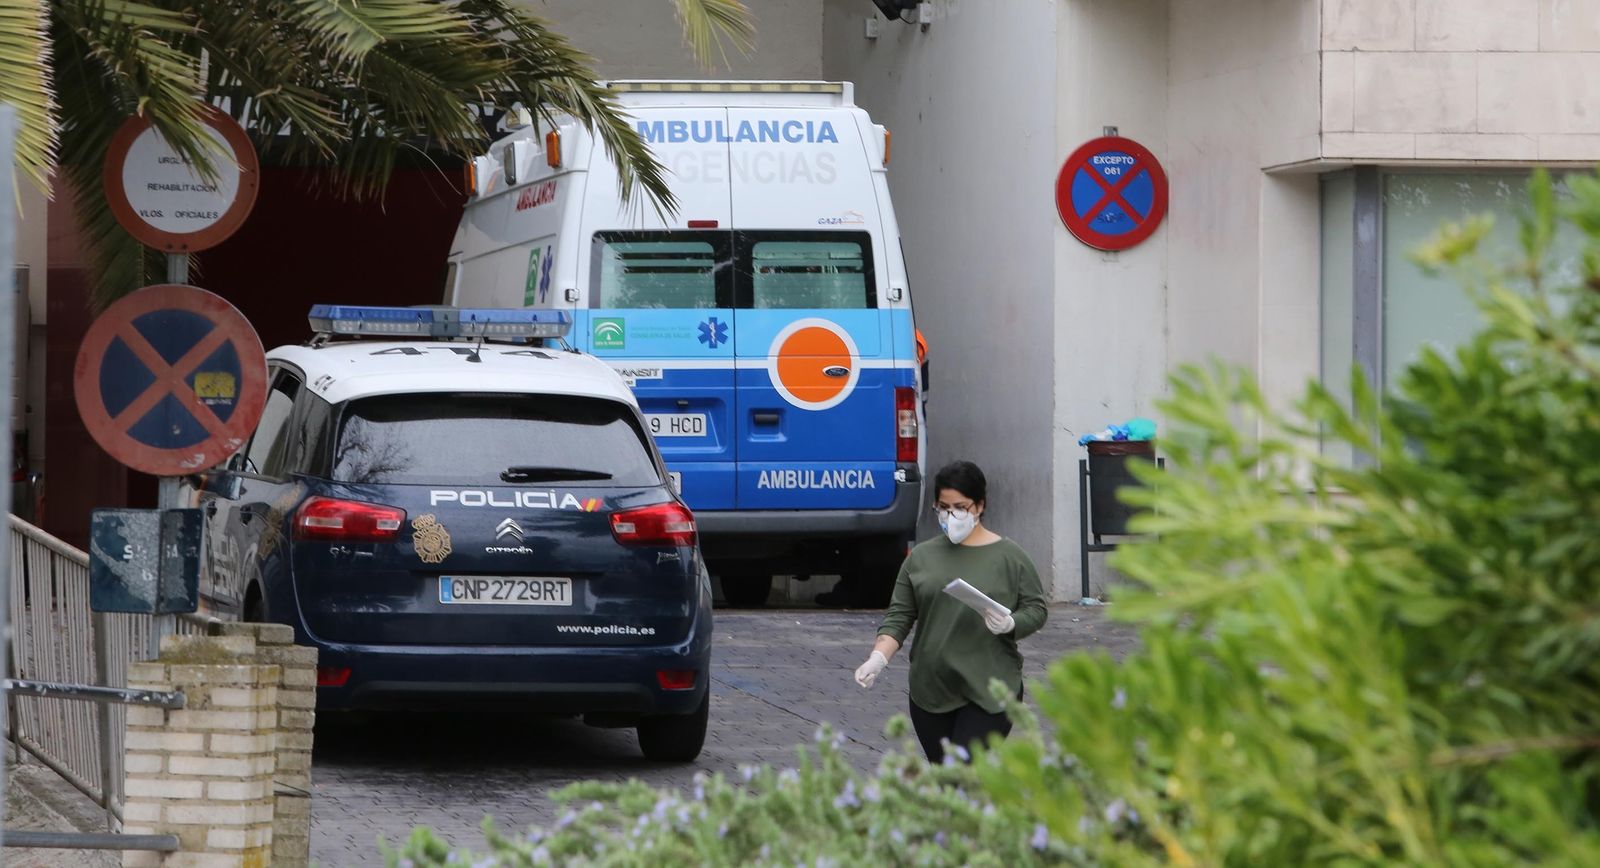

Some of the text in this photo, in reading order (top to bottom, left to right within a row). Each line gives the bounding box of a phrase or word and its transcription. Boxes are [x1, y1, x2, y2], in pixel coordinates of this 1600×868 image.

[637, 120, 839, 143] MBULANCIA
[1093, 155, 1134, 165] EXCEPTO
[672, 151, 837, 184] GENCIAS
[1104, 167, 1121, 175] 061
[175, 210, 218, 219] OFICIALES
[613, 368, 660, 377] ANSIT
[671, 418, 702, 433] HCD
[757, 469, 875, 489] AMBULANCIA
[556, 624, 656, 636] www.policia.es
